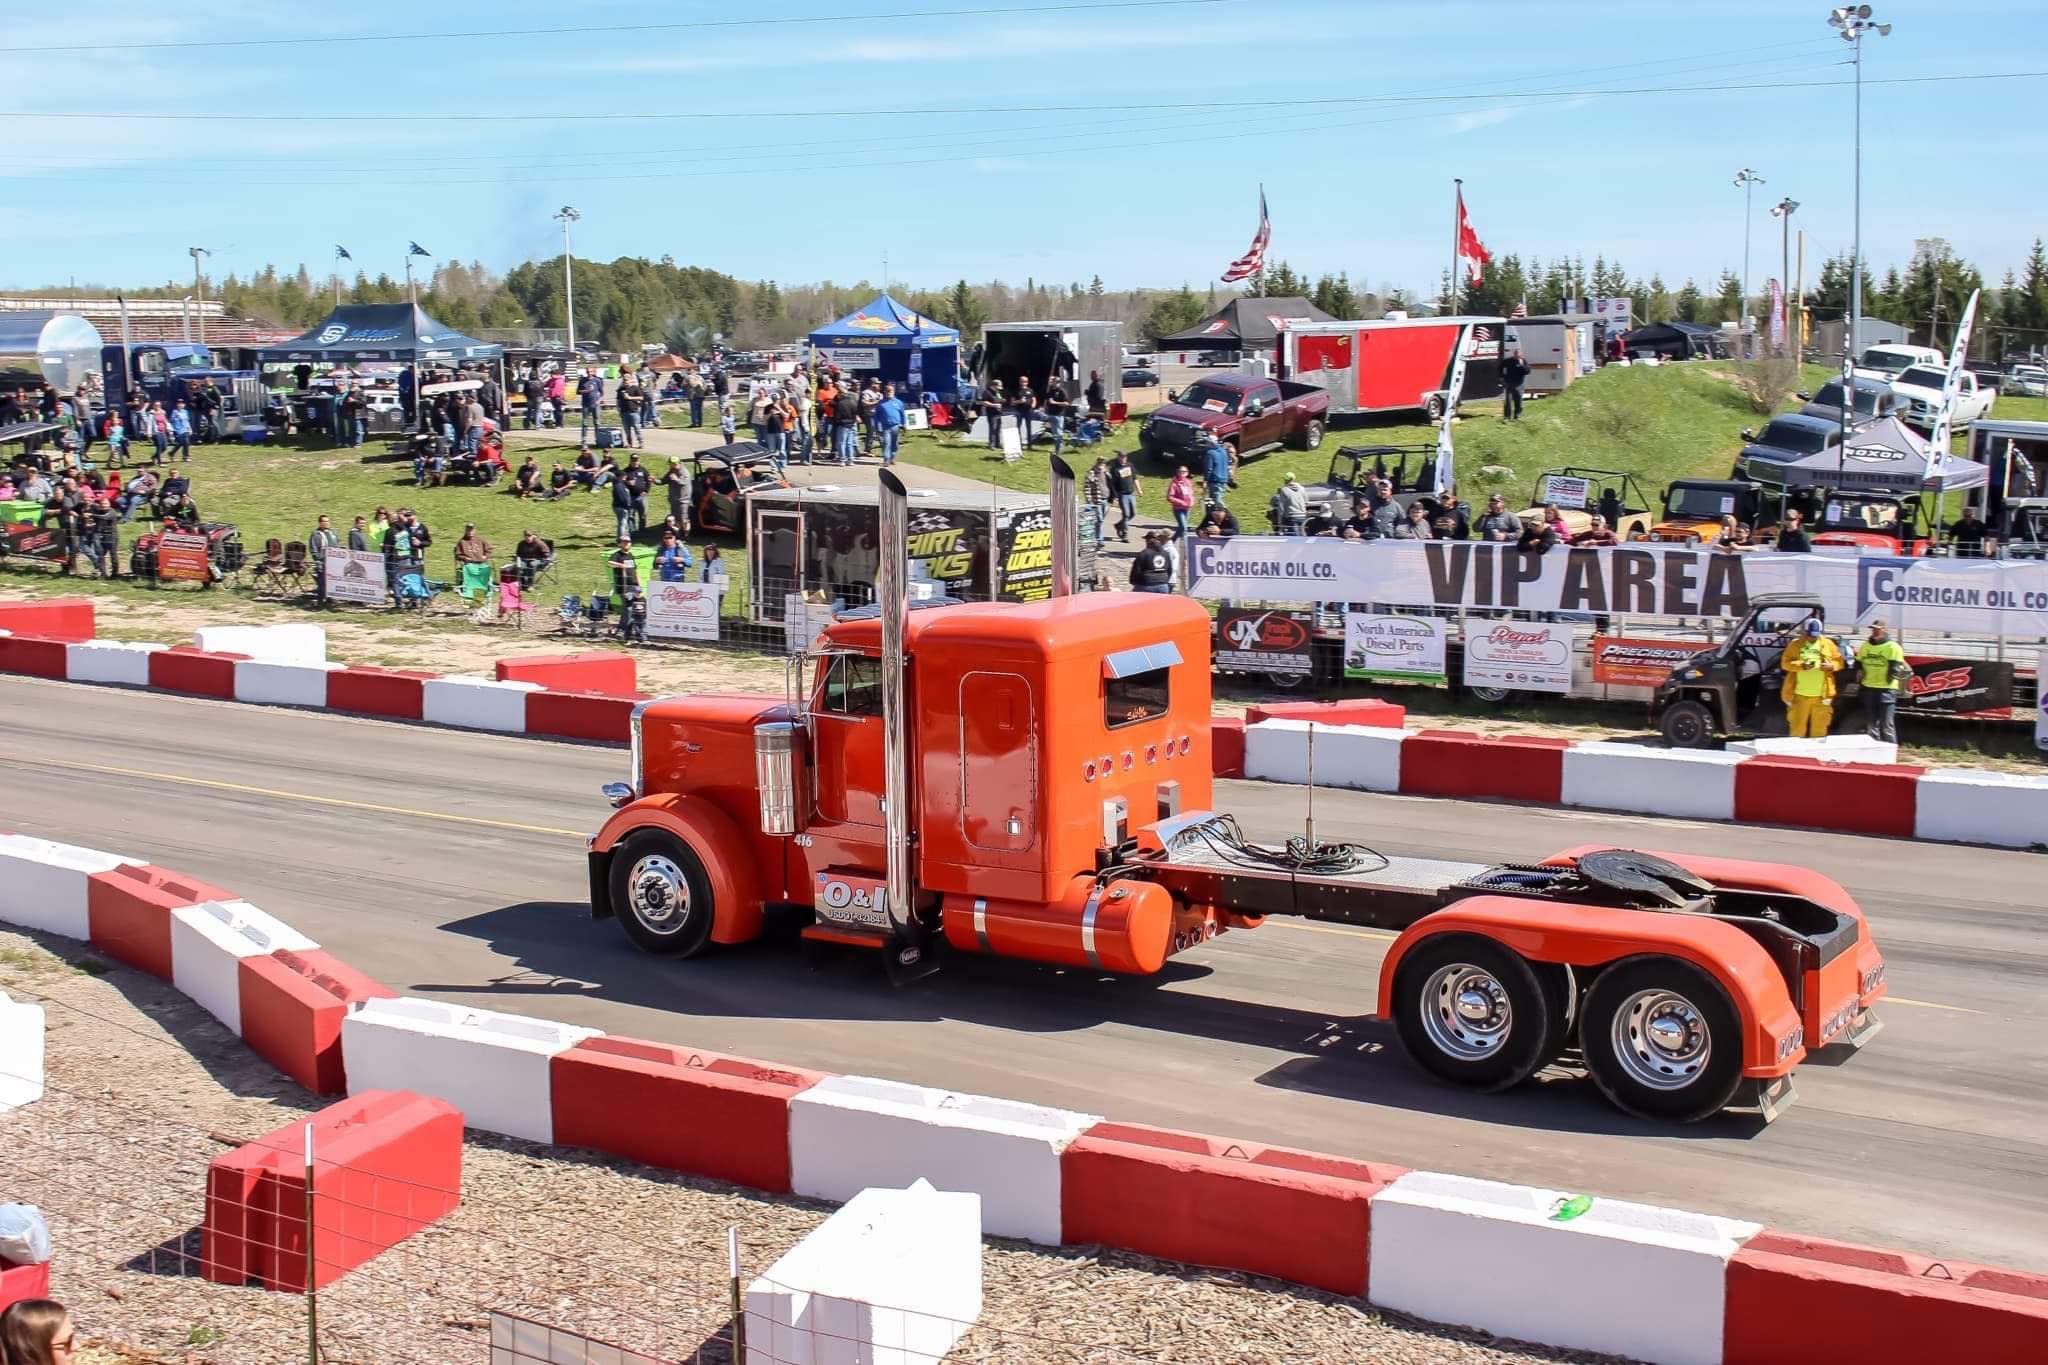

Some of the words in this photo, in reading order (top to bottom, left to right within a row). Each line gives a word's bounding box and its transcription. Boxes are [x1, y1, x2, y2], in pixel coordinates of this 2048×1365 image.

[1200, 547, 1280, 577] CORRIGAN
[1285, 562, 1307, 577] OIL
[1312, 563, 1337, 578] CO.
[1425, 543, 1541, 607] VIP
[1560, 548, 1750, 617] AREA
[1873, 570, 1979, 605] CORRIGAN
[1987, 590, 2016, 607] OIL
[1356, 622, 1385, 635] North
[1387, 624, 1435, 637] American
[1488, 625, 1551, 649] Royal
[1366, 636, 1396, 650] Diesel
[1400, 639, 1425, 651] Parts
[1601, 644, 1692, 659] PRECISION
[1602, 656, 1643, 664] FLEET
